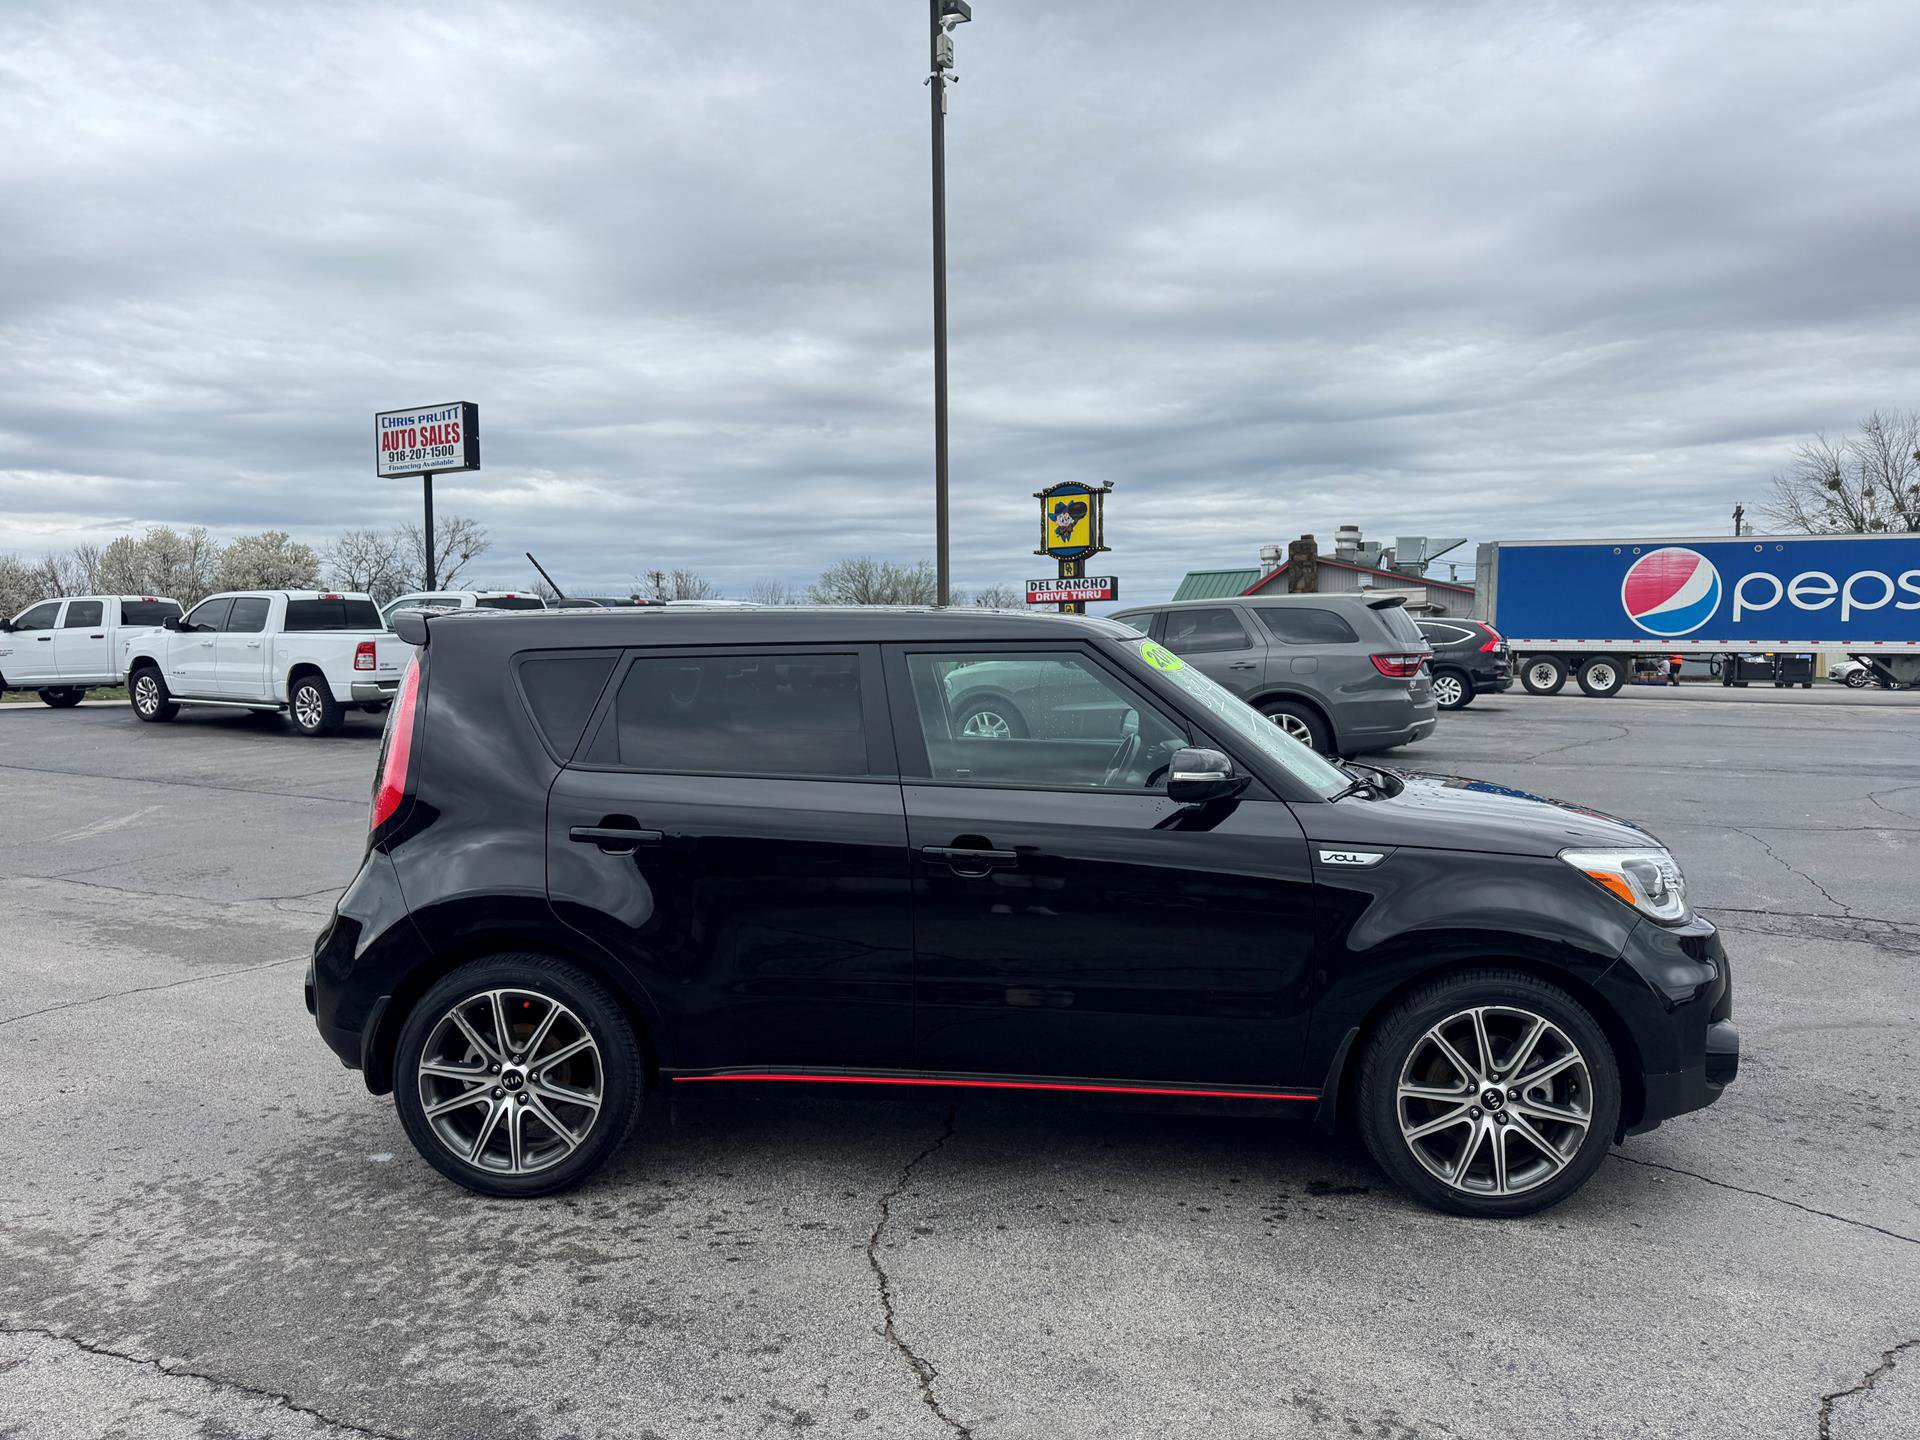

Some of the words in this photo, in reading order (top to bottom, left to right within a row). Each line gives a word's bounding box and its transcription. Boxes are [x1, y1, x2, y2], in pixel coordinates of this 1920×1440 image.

[382, 416, 415, 428] CHRIS
[418, 406, 459, 424] PRUITT
[382, 428, 417, 452] AUTO
[420, 422, 461, 447] SALES
[388, 445, 454, 462] 918-207-1500
[388, 462, 421, 471] Financing
[422, 458, 454, 468] Available
[1030, 581, 1052, 591] DEL
[1056, 578, 1107, 590] RANCHO
[1035, 590, 1068, 602] DRIVE
[1071, 589, 1102, 600] THRU
[503, 1076, 522, 1087] KIA
[1485, 1091, 1500, 1109] KIA
